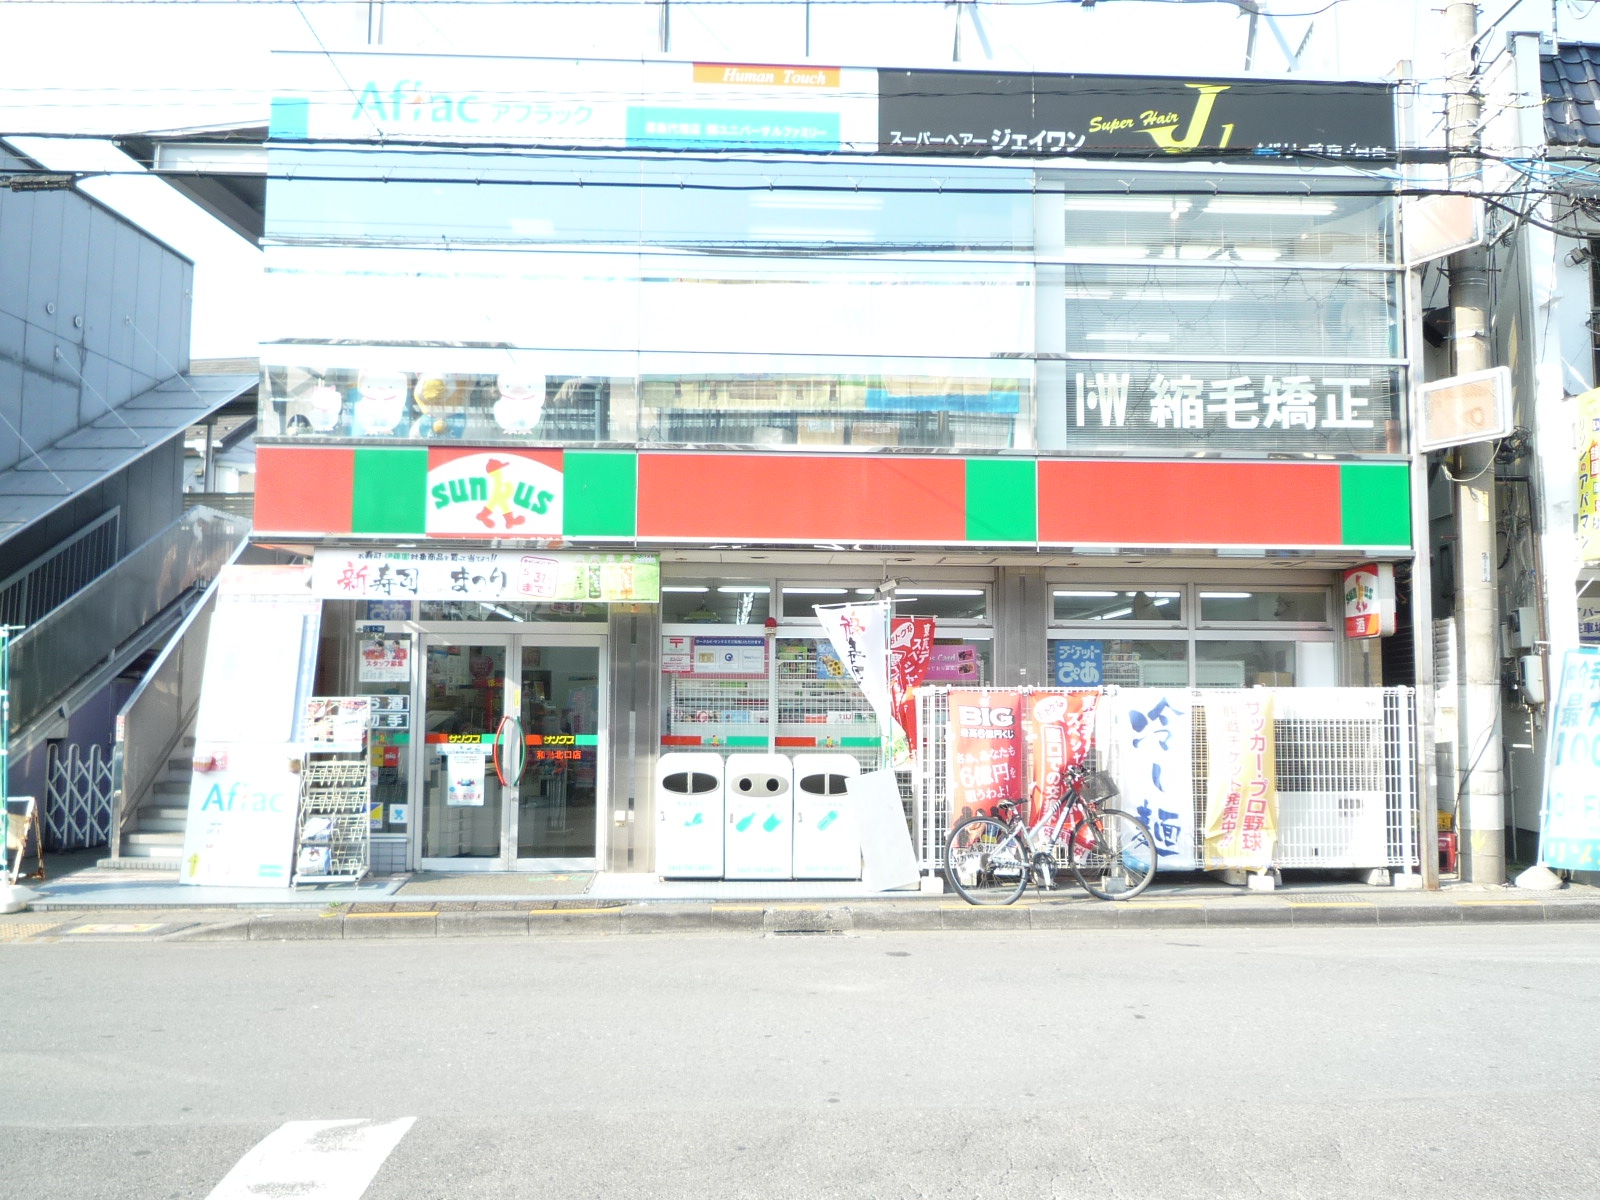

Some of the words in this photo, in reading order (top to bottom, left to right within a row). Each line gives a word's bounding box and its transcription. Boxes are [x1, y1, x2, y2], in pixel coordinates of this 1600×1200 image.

[723, 67, 774, 83] Human
[783, 69, 827, 86] Touch
[490, 103, 593, 126] アフラック
[1088, 114, 1134, 136] Super
[1139, 109, 1180, 128] Hair
[890, 129, 988, 148] スーパーヘアー
[989, 128, 1087, 153] ジェイワン
[1149, 375, 1375, 430] 縮毛矯正
[1058, 644, 1101, 659] チケット
[366, 660, 404, 668] スタッフ募集
[1058, 660, 1100, 684] ぴあ
[958, 704, 1015, 727] BIG
[448, 734, 481, 745] サンクス
[544, 735, 575, 746] サンクス
[1128, 696, 1186, 858] 冷し麺
